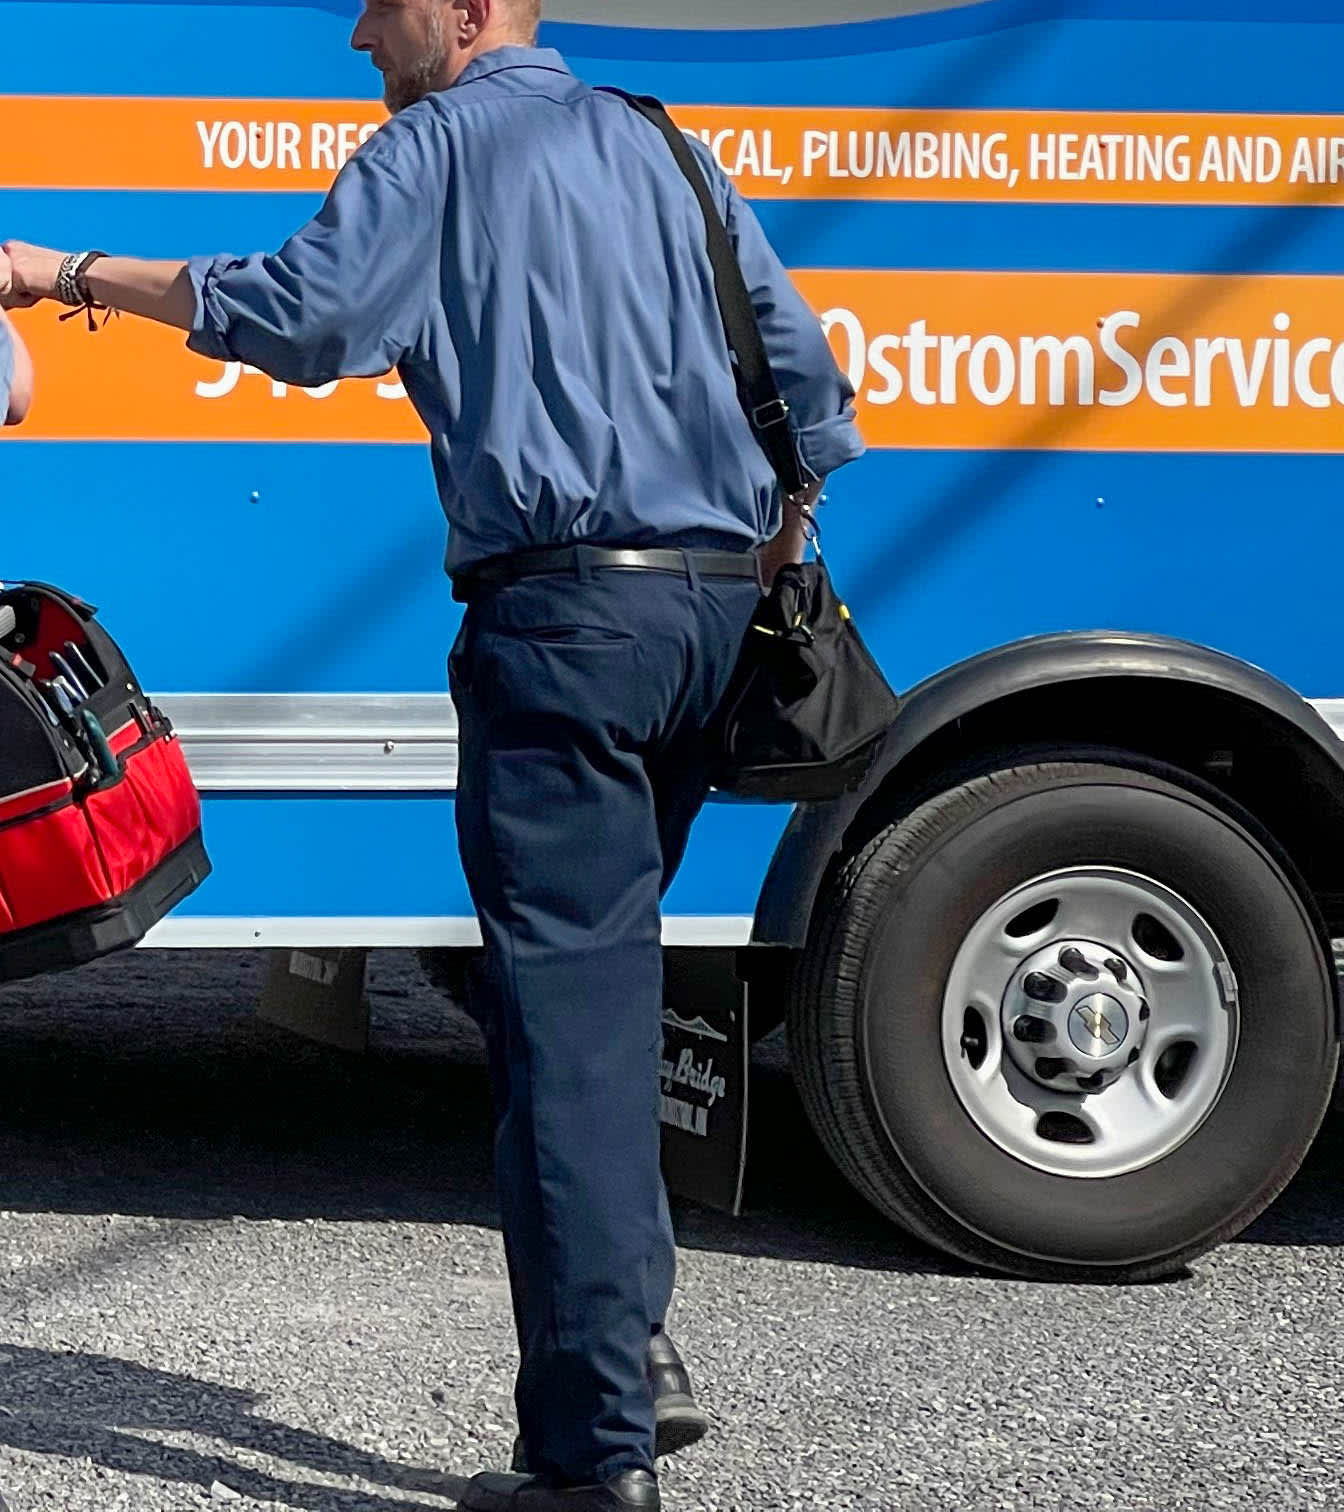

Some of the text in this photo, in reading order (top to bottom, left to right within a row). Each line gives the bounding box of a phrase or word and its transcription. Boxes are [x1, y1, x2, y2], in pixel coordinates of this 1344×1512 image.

[195, 120, 303, 169] YOUR
[802, 130, 1019, 187] PLUMBING,
[1030, 133, 1191, 183] HEATING
[1199, 134, 1282, 184] AND
